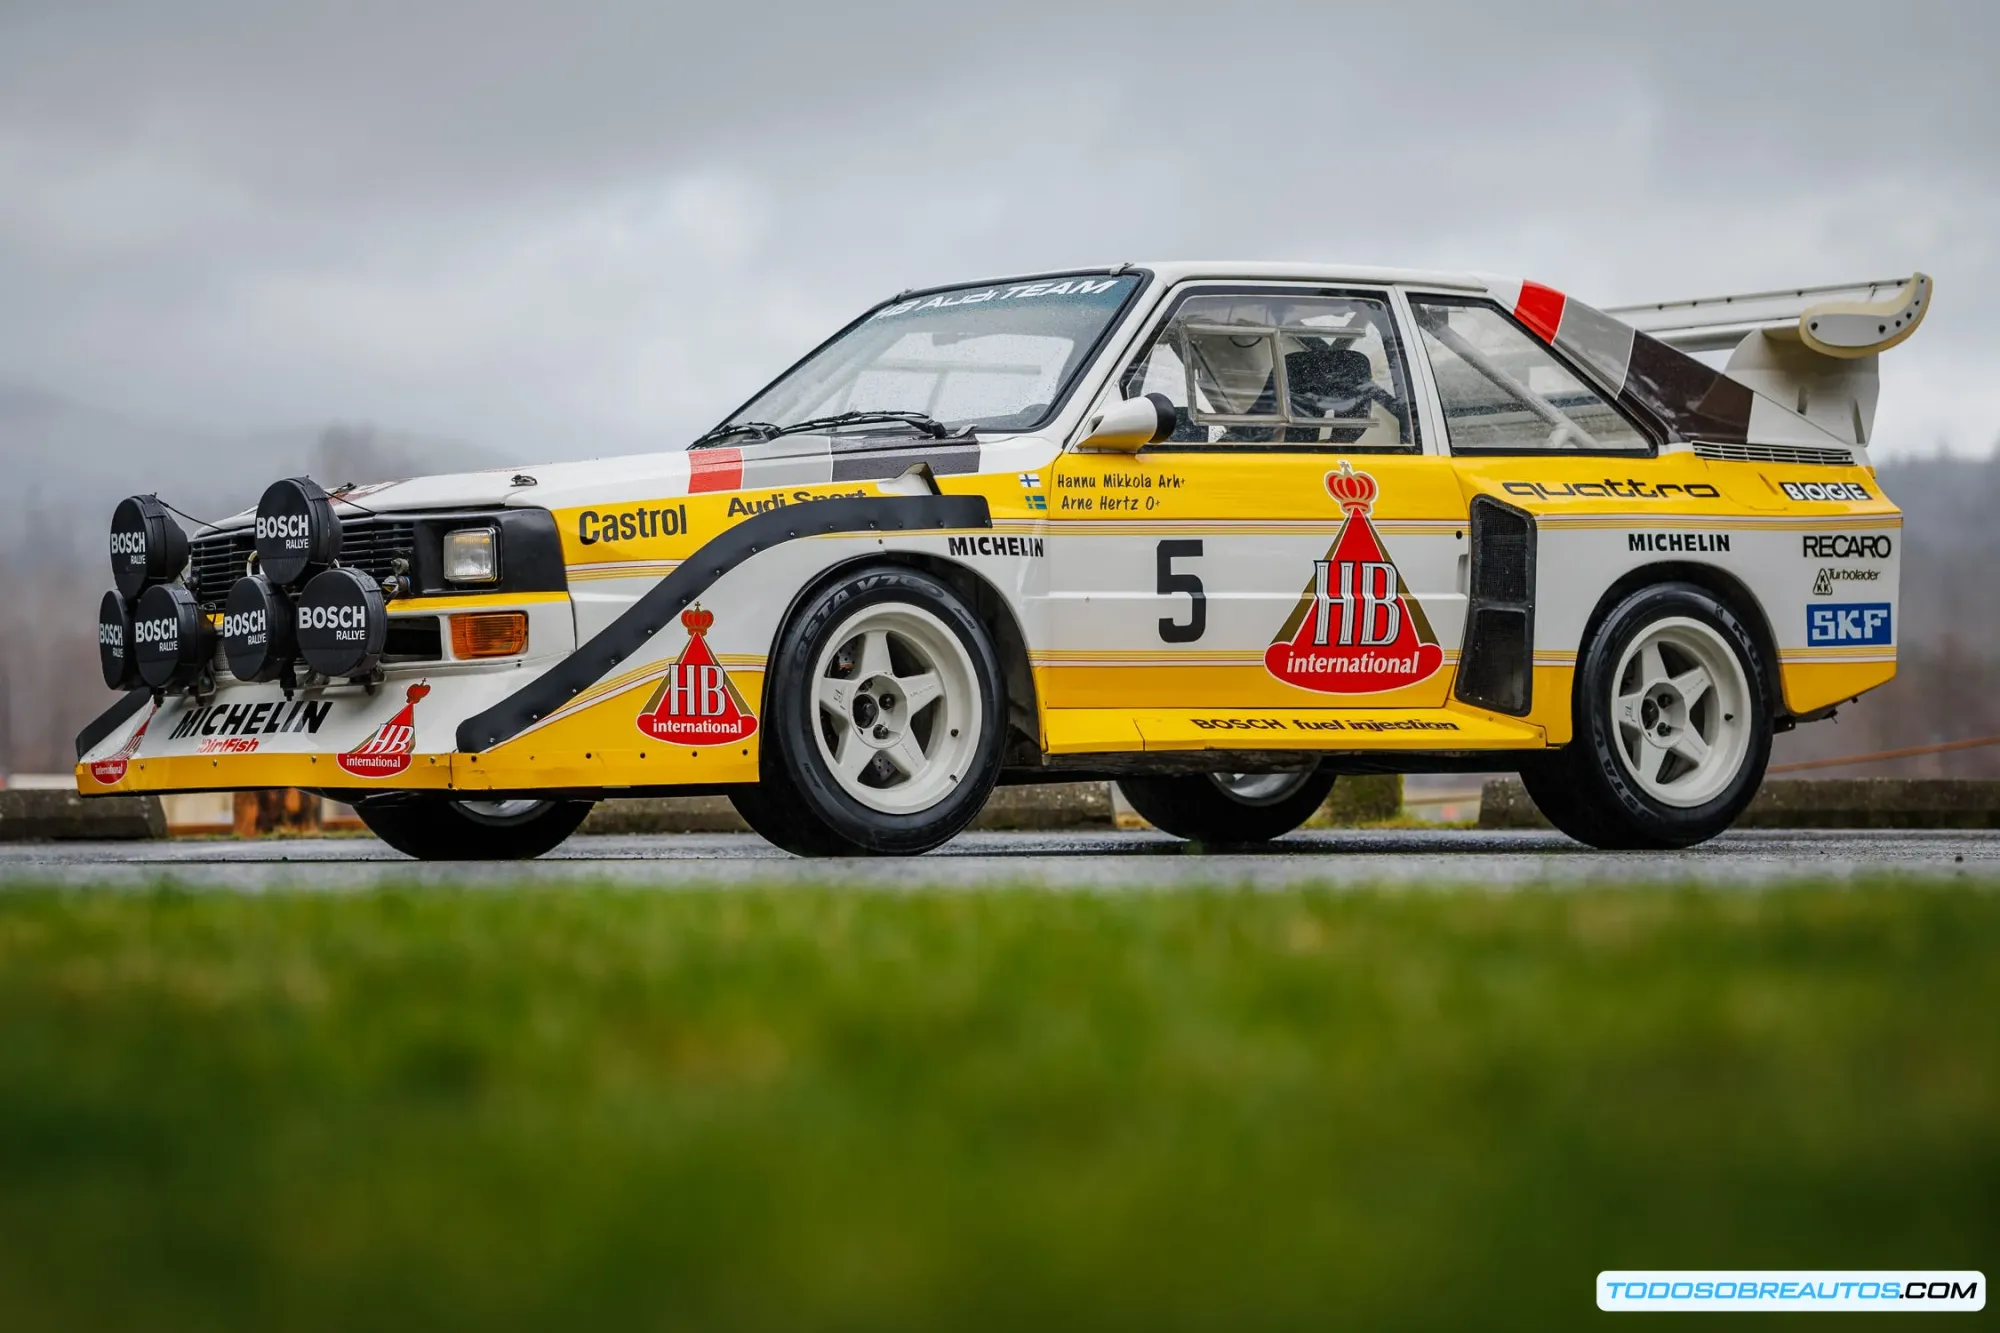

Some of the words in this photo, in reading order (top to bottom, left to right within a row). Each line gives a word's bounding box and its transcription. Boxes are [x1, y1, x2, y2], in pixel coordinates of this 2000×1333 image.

[915, 290, 1000, 312] Audi
[1000, 280, 1118, 300] TEAM
[1057, 474, 1096, 488] Hannu
[1103, 473, 1152, 488] Mikkola
[1501, 479, 1720, 498] quattro
[1783, 483, 1869, 500] BOGE
[727, 493, 787, 517] Audi
[1061, 495, 1093, 510] Arne
[1100, 496, 1138, 510] Hertz
[256, 514, 309, 539] BOSCH
[579, 504, 687, 546] Castrol
[110, 531, 145, 553] BOSCH
[285, 538, 309, 550] RALLYE
[947, 537, 1044, 558] MICHELIN
[1628, 533, 1730, 552] MICHELIN
[1803, 535, 1892, 558] RECARO
[1828, 568, 1881, 580] Turbolader
[1157, 539, 1206, 643] 5
[1313, 560, 1400, 646] HB
[224, 609, 266, 638] BOSCH
[298, 606, 365, 629] BOSCH
[1811, 609, 1887, 640] SKF
[100, 623, 123, 646] BOSCH
[135, 617, 178, 643] BOSCH
[247, 632, 266, 646] RALLYE
[336, 630, 365, 640] RALLYE
[159, 641, 178, 652] RALLYE
[1287, 651, 1419, 675] international
[668, 664, 727, 717] HB
[168, 701, 334, 740] MICHELIN
[653, 718, 742, 735] international
[1190, 718, 1288, 730] BOSCH
[1292, 719, 1345, 730] fuel
[1348, 719, 1461, 732] injection
[361, 723, 414, 754] HB
[346, 755, 401, 768] international
